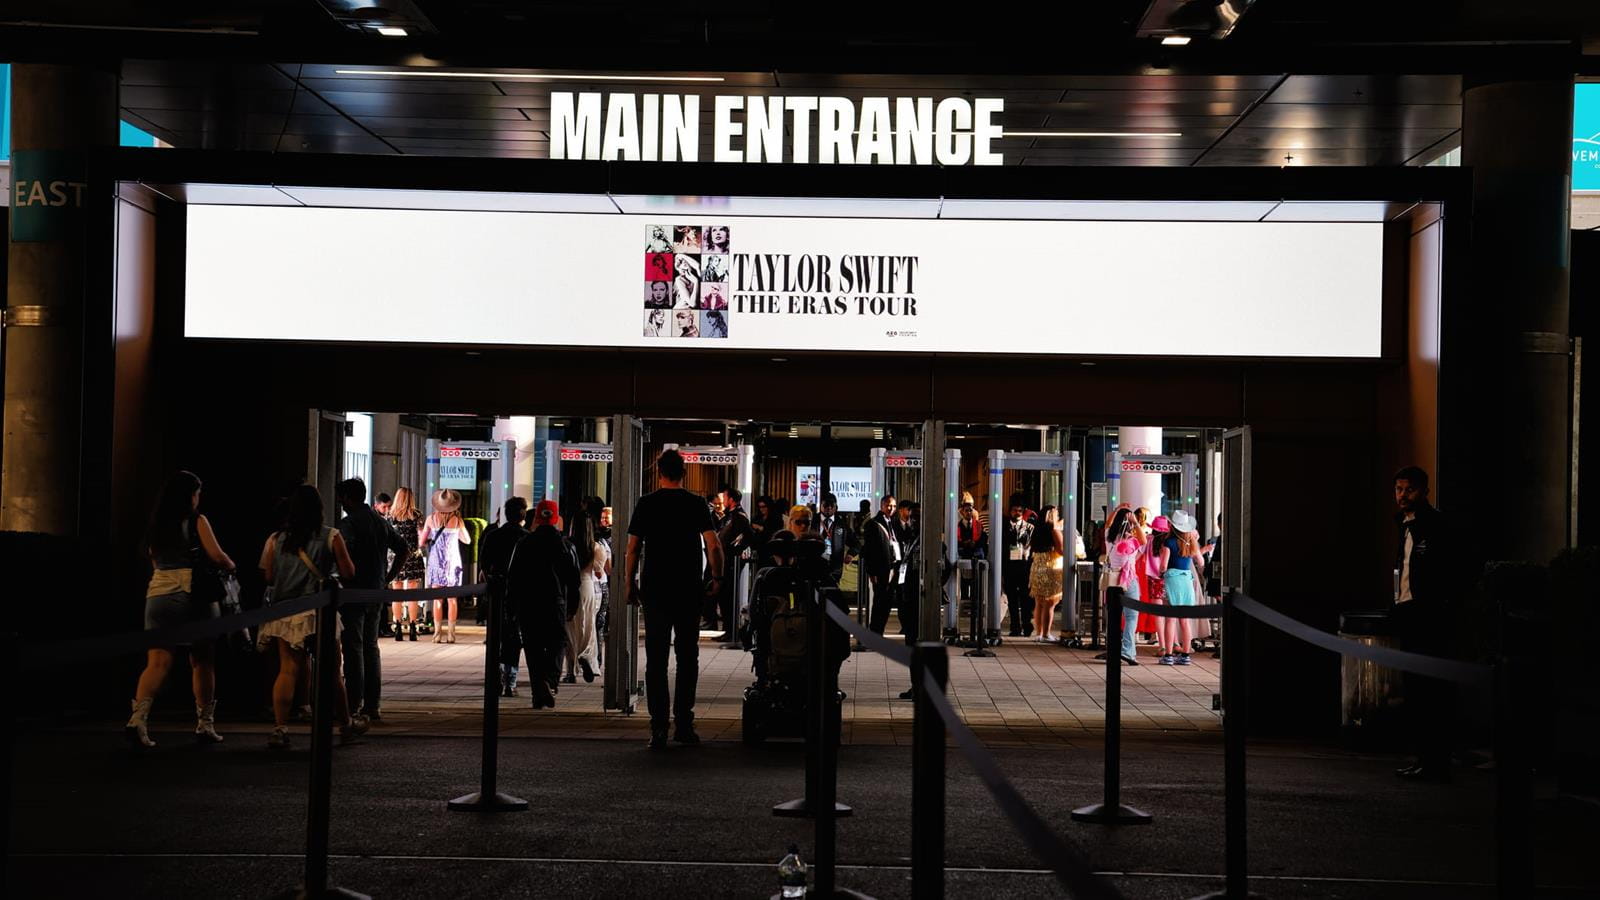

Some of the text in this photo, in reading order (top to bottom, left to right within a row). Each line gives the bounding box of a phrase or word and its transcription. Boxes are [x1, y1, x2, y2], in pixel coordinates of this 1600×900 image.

[550, 91, 1005, 166] MAIN ENTRANCE
[15, 181, 86, 207] EAST
[733, 253, 919, 295] TAYLOR SWIFT
[733, 294, 918, 316] THE ERAS TOUR
